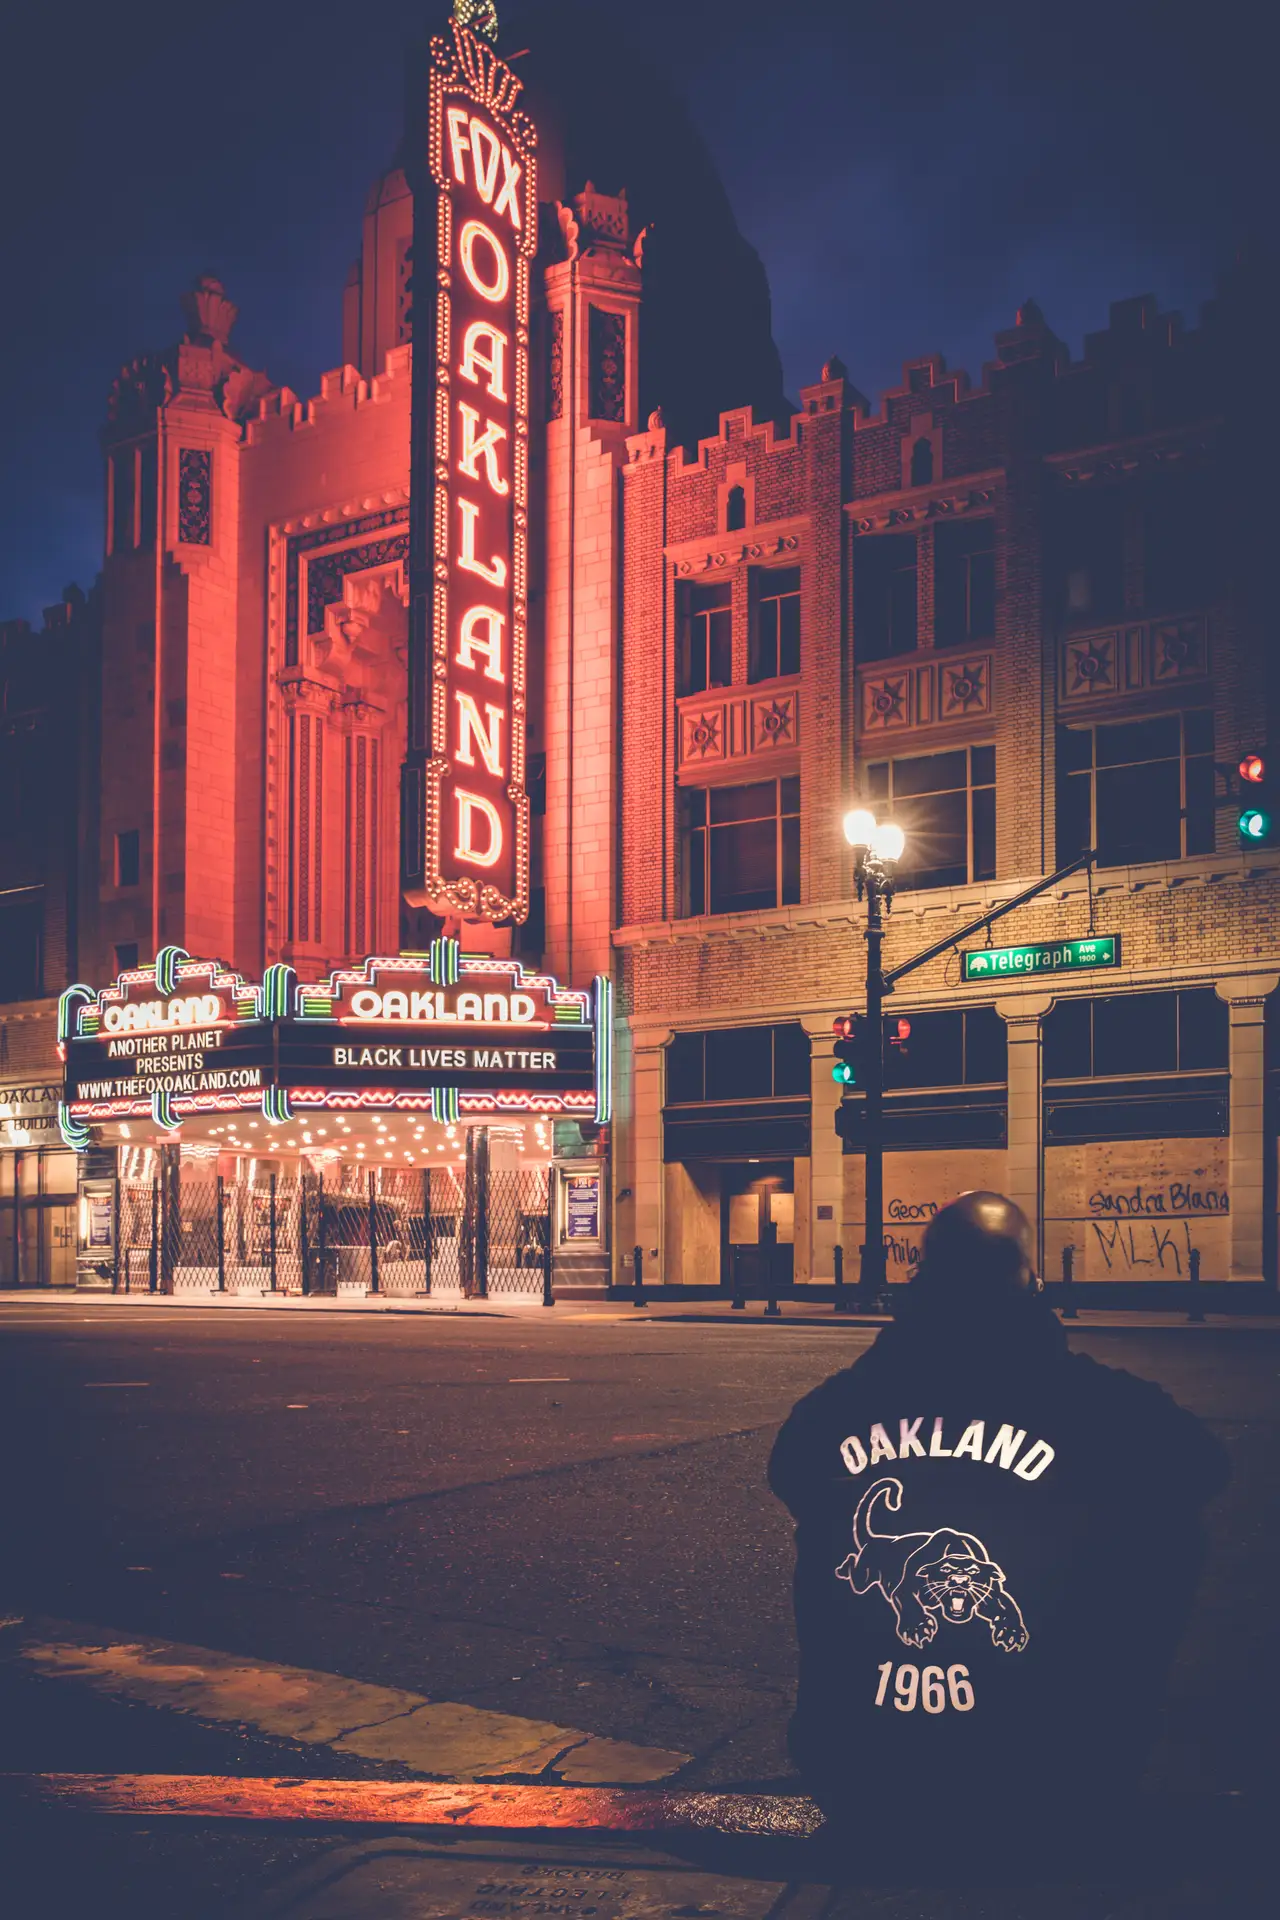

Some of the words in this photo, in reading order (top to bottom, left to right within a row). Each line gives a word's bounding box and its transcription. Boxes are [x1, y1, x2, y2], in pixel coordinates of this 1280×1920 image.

[446, 106, 522, 230] FOX
[453, 219, 510, 868] OAKLAND
[990, 946, 1072, 971] Telegraph
[1079, 944, 1096, 954] Ave
[1079, 954, 1096, 963] 1900
[103, 994, 221, 1032] OAKLAND
[351, 990, 536, 1022] OAKLAND
[108, 1036, 168, 1057] ANOTHER
[172, 1030, 223, 1052] PLANET
[136, 1052, 204, 1074] PRESENTS
[334, 1048, 402, 1066] BLACK
[410, 1049, 466, 1067] LIVES
[474, 1051, 556, 1069] MATTER
[0, 1086, 62, 1105] OAKLAN
[78, 1068, 261, 1100] WWW.THEFOXOAKLAND.COM
[14, 1115, 60, 1131] BUILDIN
[839, 1416, 1055, 1482] OAKLAND
[874, 1660, 976, 1714] 1966
